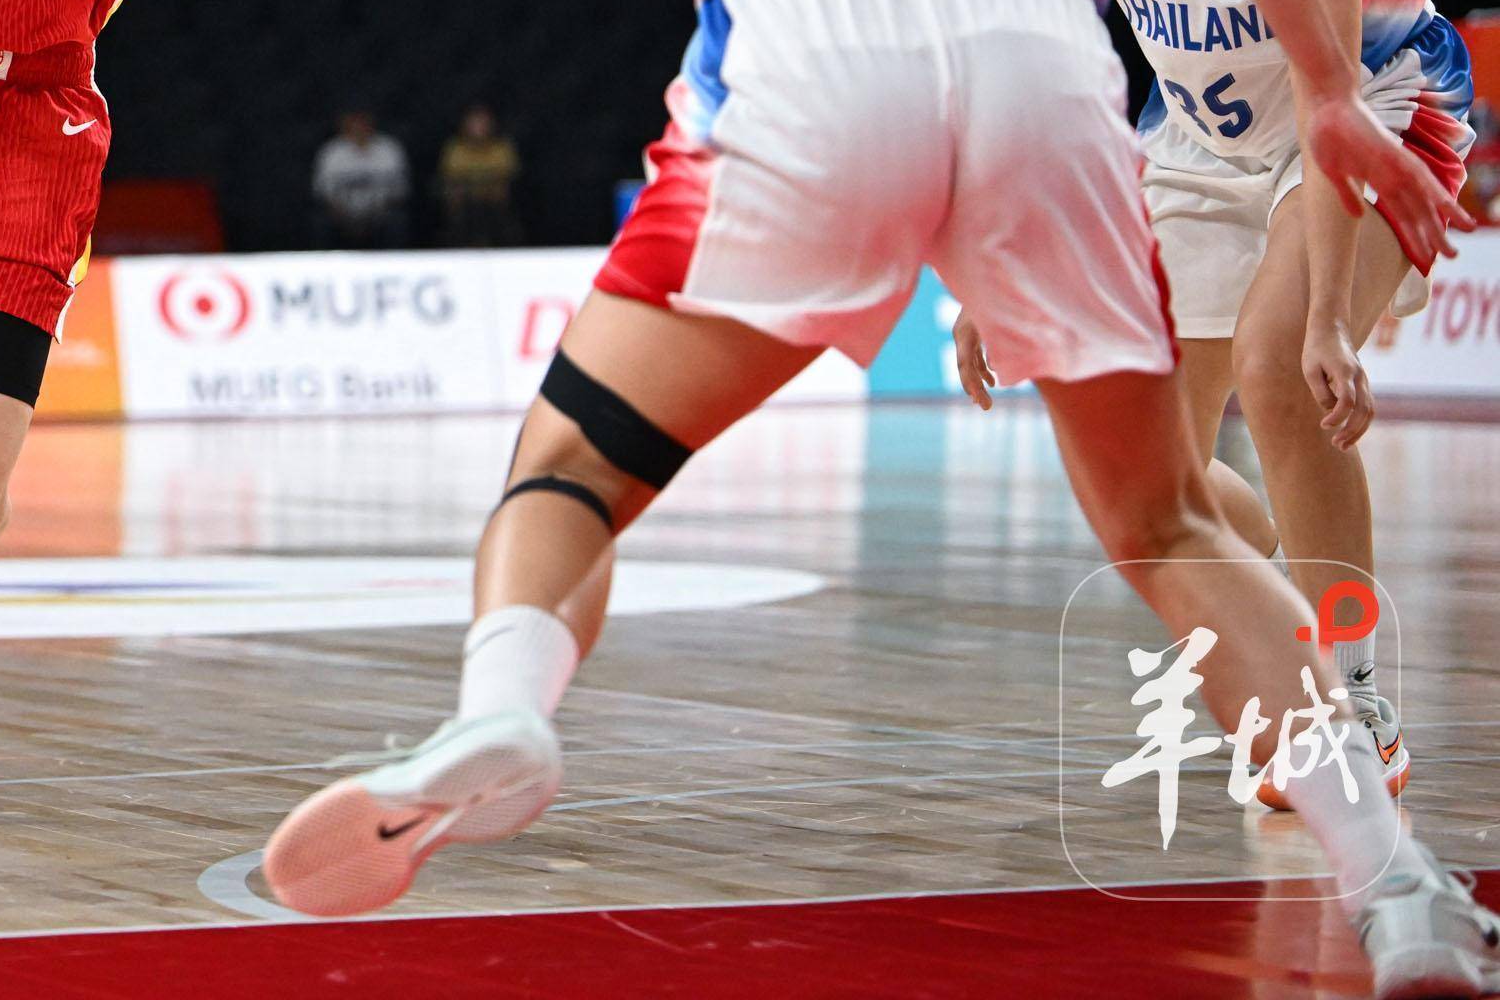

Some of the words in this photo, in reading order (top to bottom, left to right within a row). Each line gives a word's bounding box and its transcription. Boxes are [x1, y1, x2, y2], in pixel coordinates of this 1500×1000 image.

[271, 274, 456, 327] MUFG
[1422, 279, 1500, 344] TOY
[190, 371, 324, 403] MUFG
[339, 367, 442, 398] Bank
